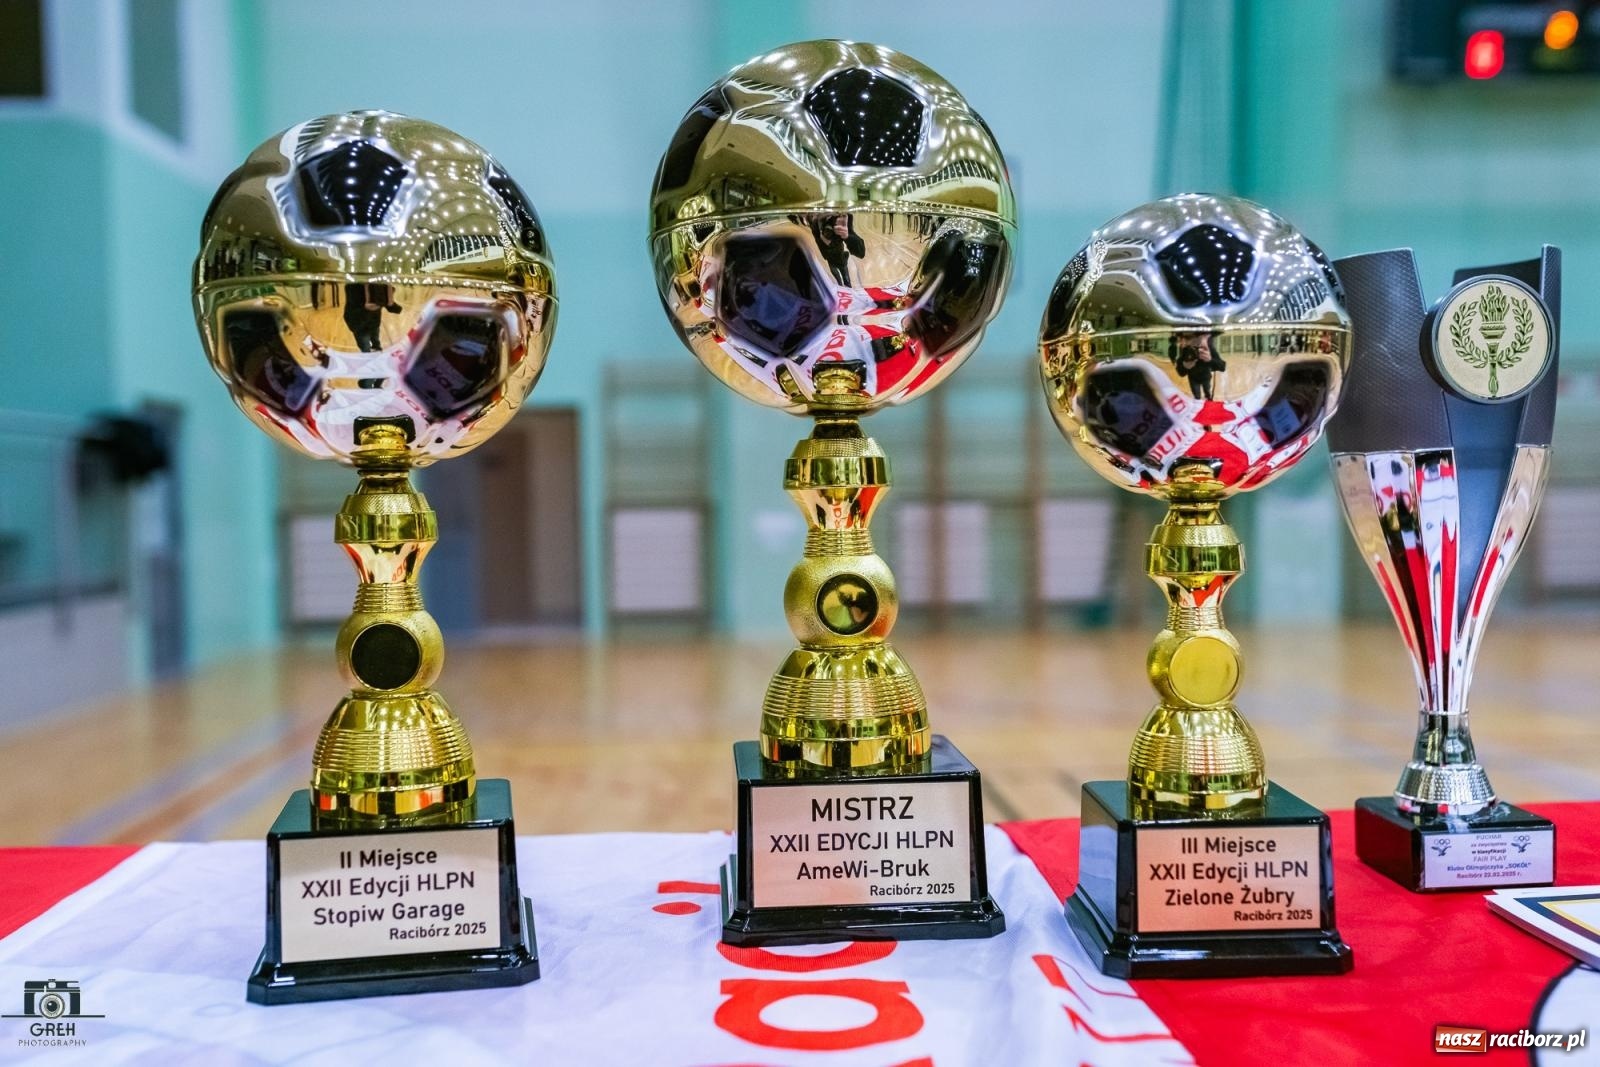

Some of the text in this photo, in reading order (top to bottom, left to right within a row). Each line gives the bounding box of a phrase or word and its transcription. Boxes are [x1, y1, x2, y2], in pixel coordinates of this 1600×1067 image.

[811, 796, 914, 822] MISTRZ
[770, 830, 954, 853] XXII EDYCJI HLPN
[1182, 836, 1277, 857] III Miejsce
[340, 850, 438, 870] II Miejsce
[797, 859, 930, 881] AmeWi-Bruk
[1150, 861, 1308, 883] XXII Edycji HLPN
[301, 871, 475, 899] XXII Edycji HLPN
[870, 883, 955, 897] Racibórz 2025
[1165, 885, 1295, 907] Zielone Żubry
[313, 903, 465, 927] Stopiw Garage
[1234, 910, 1313, 921] Racibórz 2025
[389, 921, 487, 940] Racibórz 2025
